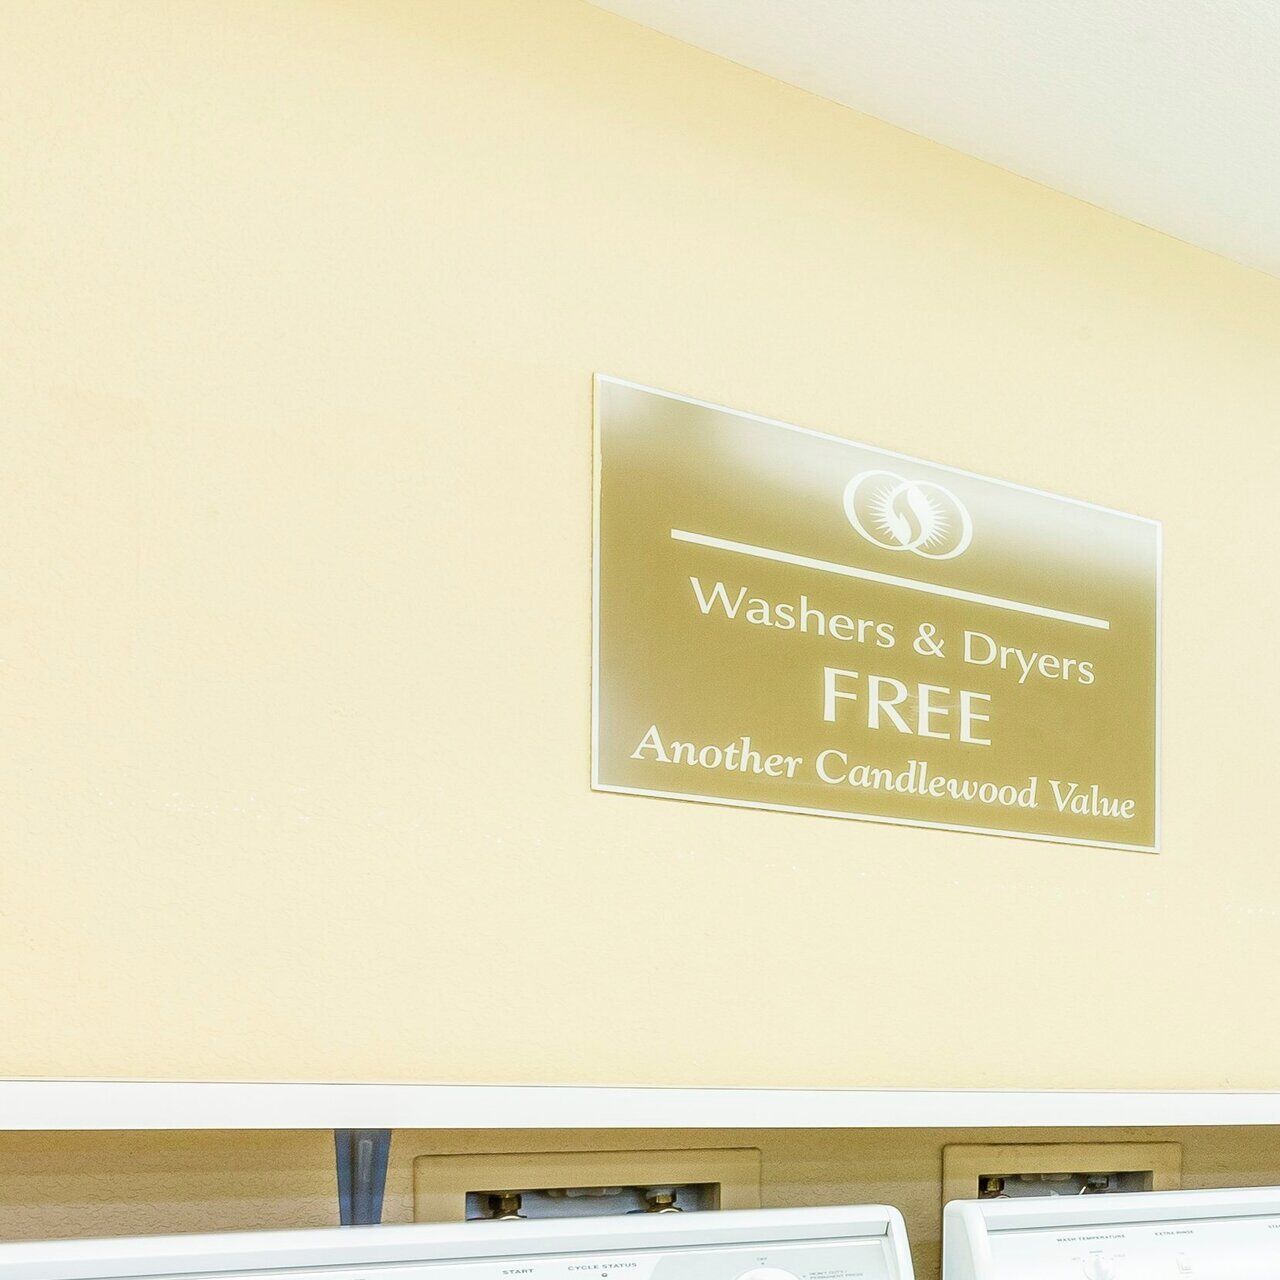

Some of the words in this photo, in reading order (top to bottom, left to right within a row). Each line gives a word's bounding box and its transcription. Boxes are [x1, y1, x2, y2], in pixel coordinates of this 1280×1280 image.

[689, 576, 896, 649] Washers
[912, 622, 945, 658] &
[963, 630, 1096, 685] Dryers
[822, 666, 992, 746] FREE
[630, 724, 803, 778] Another
[814, 748, 1039, 809] Candlewood
[1048, 780, 1136, 820] Value
[568, 1264, 599, 1272] CYCLE
[602, 1262, 638, 1270] STATUS
